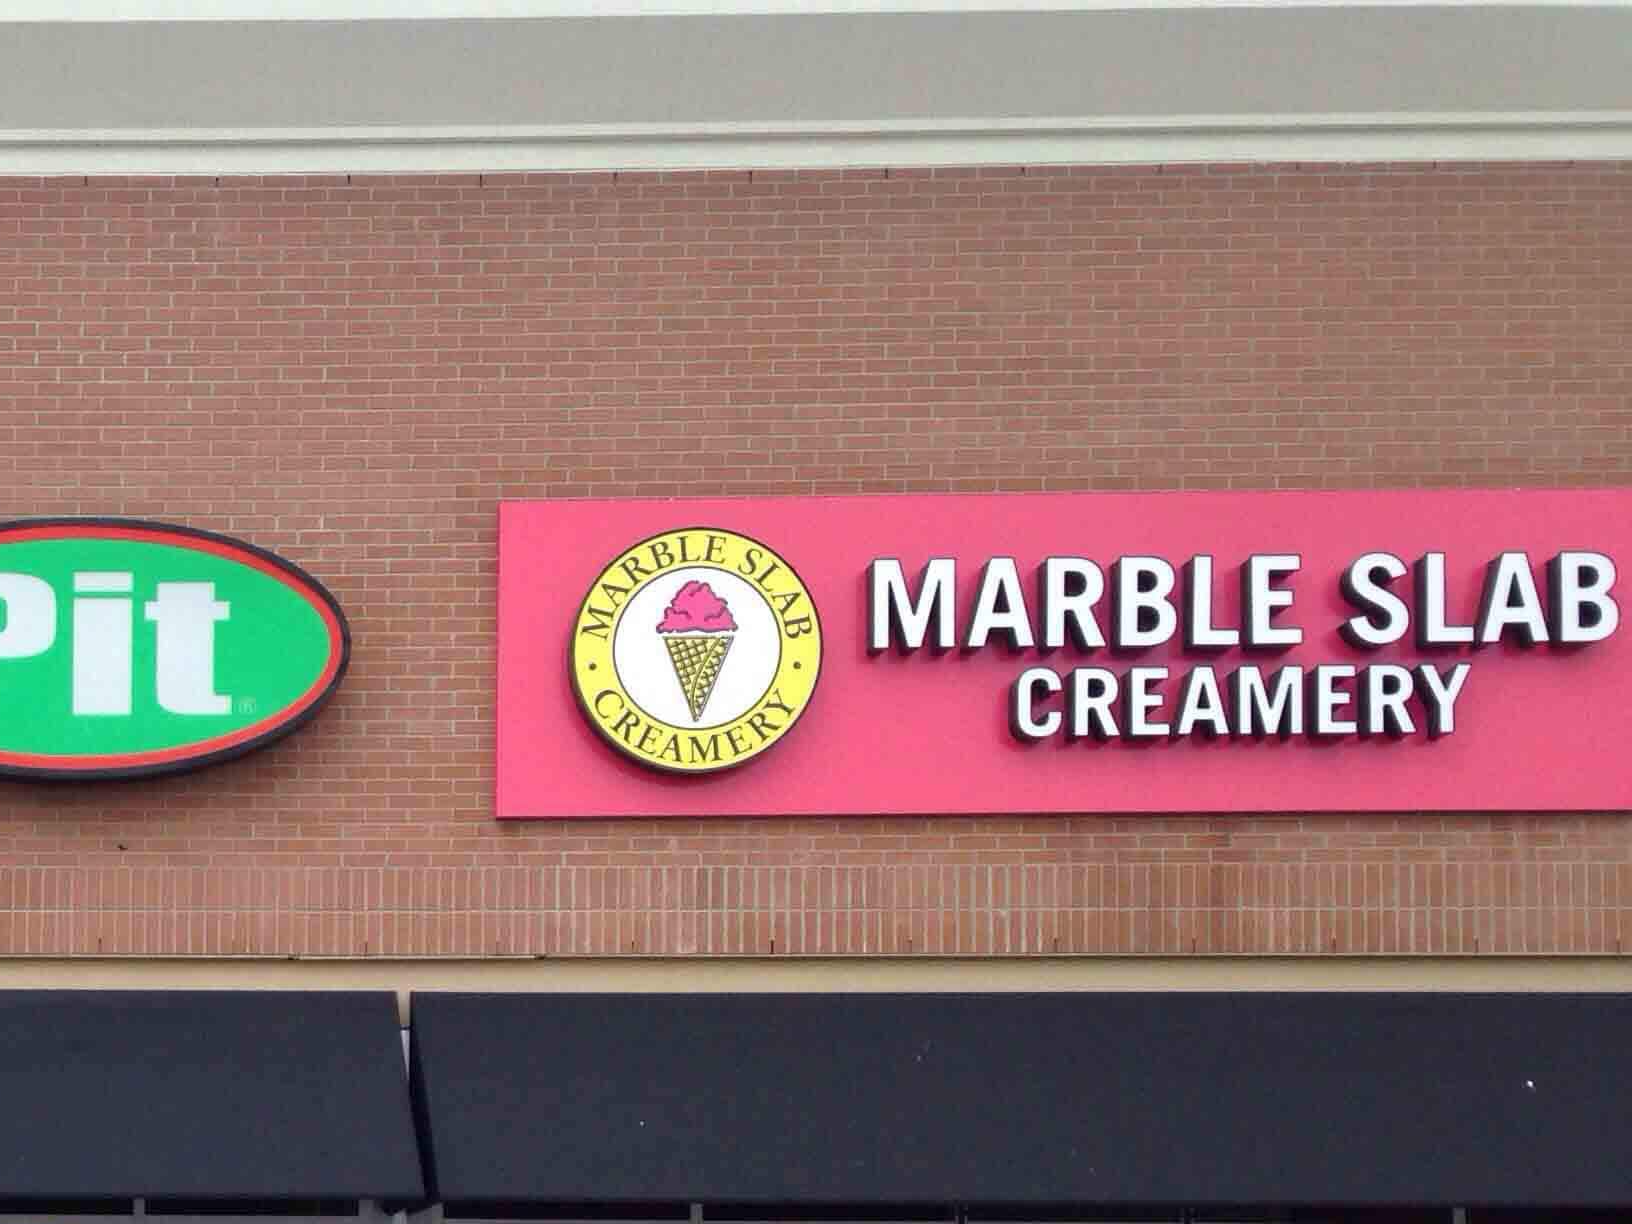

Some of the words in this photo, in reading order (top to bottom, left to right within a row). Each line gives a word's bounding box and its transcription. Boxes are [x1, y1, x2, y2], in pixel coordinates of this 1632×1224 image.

[579, 534, 728, 641] MARBLE
[737, 546, 814, 640] SLAB
[868, 553, 1305, 655] MARBLE
[1342, 551, 1619, 649] SLAB
[594, 687, 797, 764] CREAMERY
[1013, 662, 1471, 740] CREAMERY
